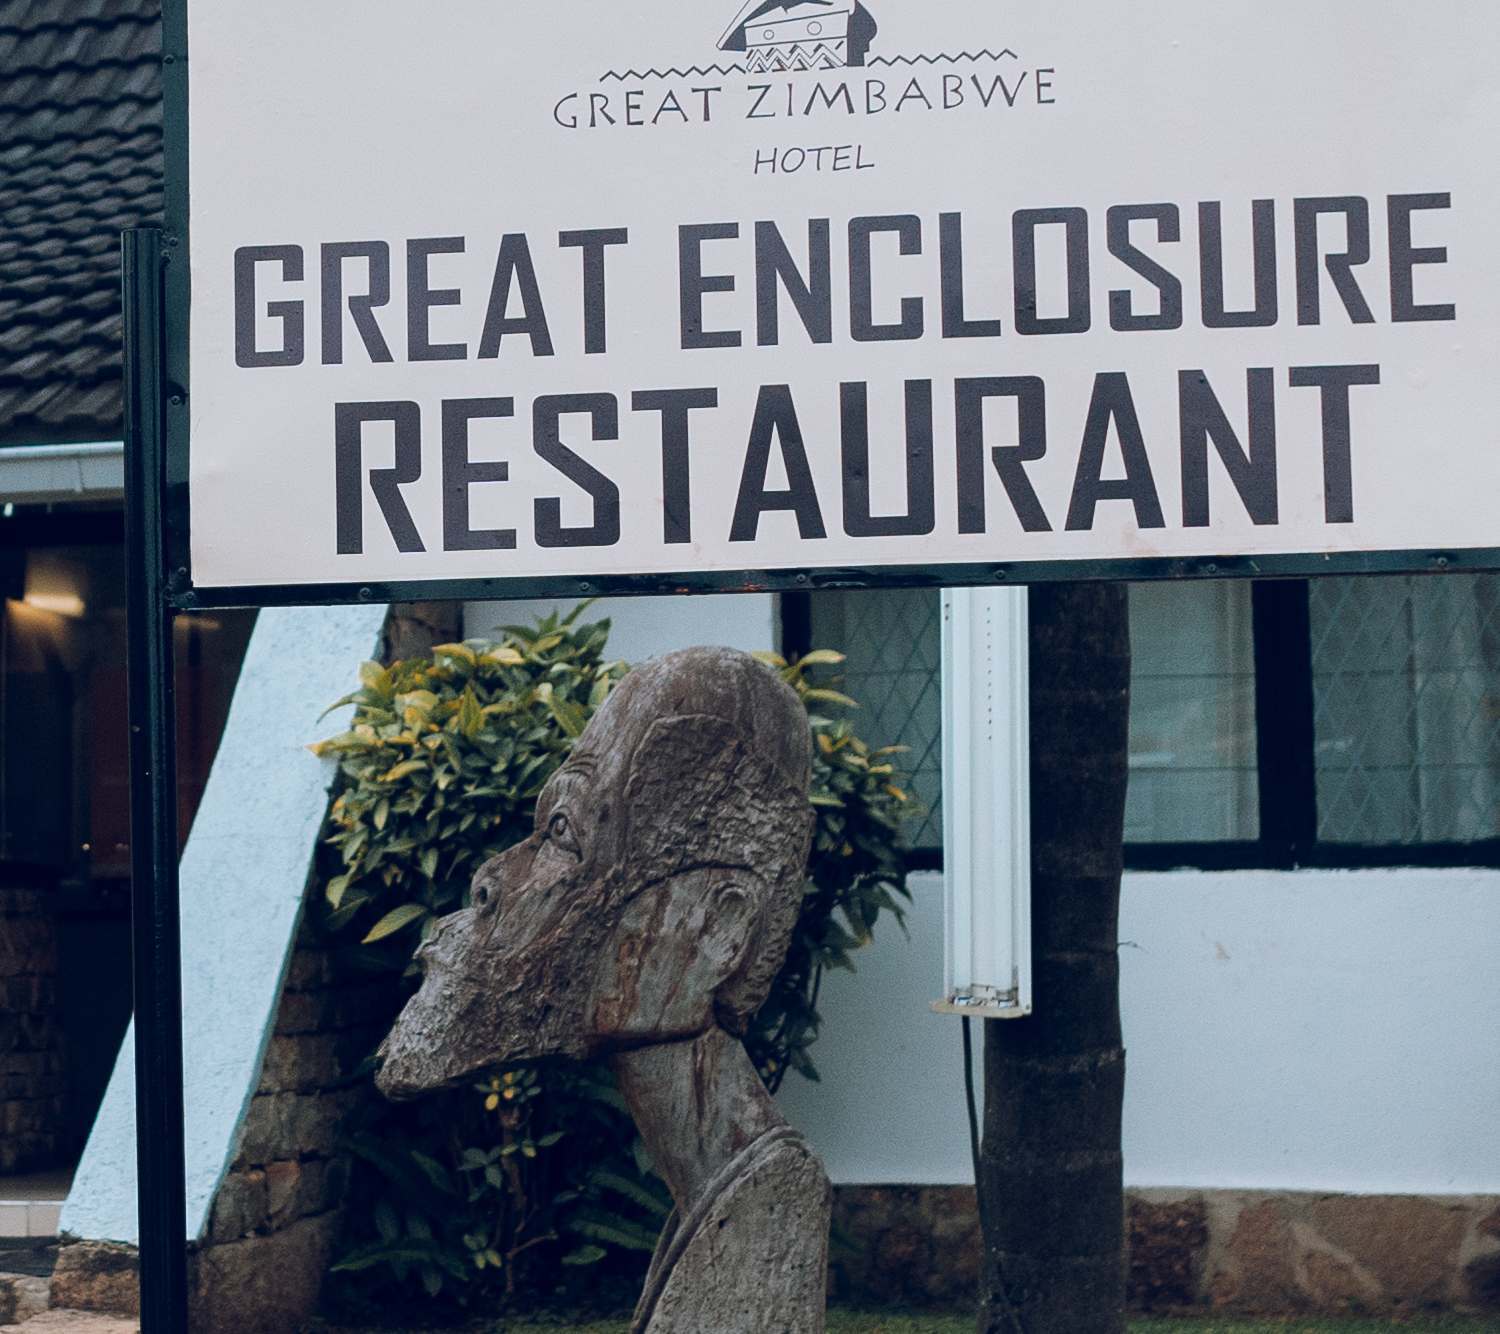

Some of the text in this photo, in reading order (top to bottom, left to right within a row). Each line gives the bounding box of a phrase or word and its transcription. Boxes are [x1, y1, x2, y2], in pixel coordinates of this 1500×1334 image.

[552, 67, 1057, 130] GREAT ZIMBABWE
[753, 143, 876, 175] HOTEL
[233, 191, 1456, 369] GREAT ENCLOSURE
[333, 363, 1381, 556] RESTAURANT
